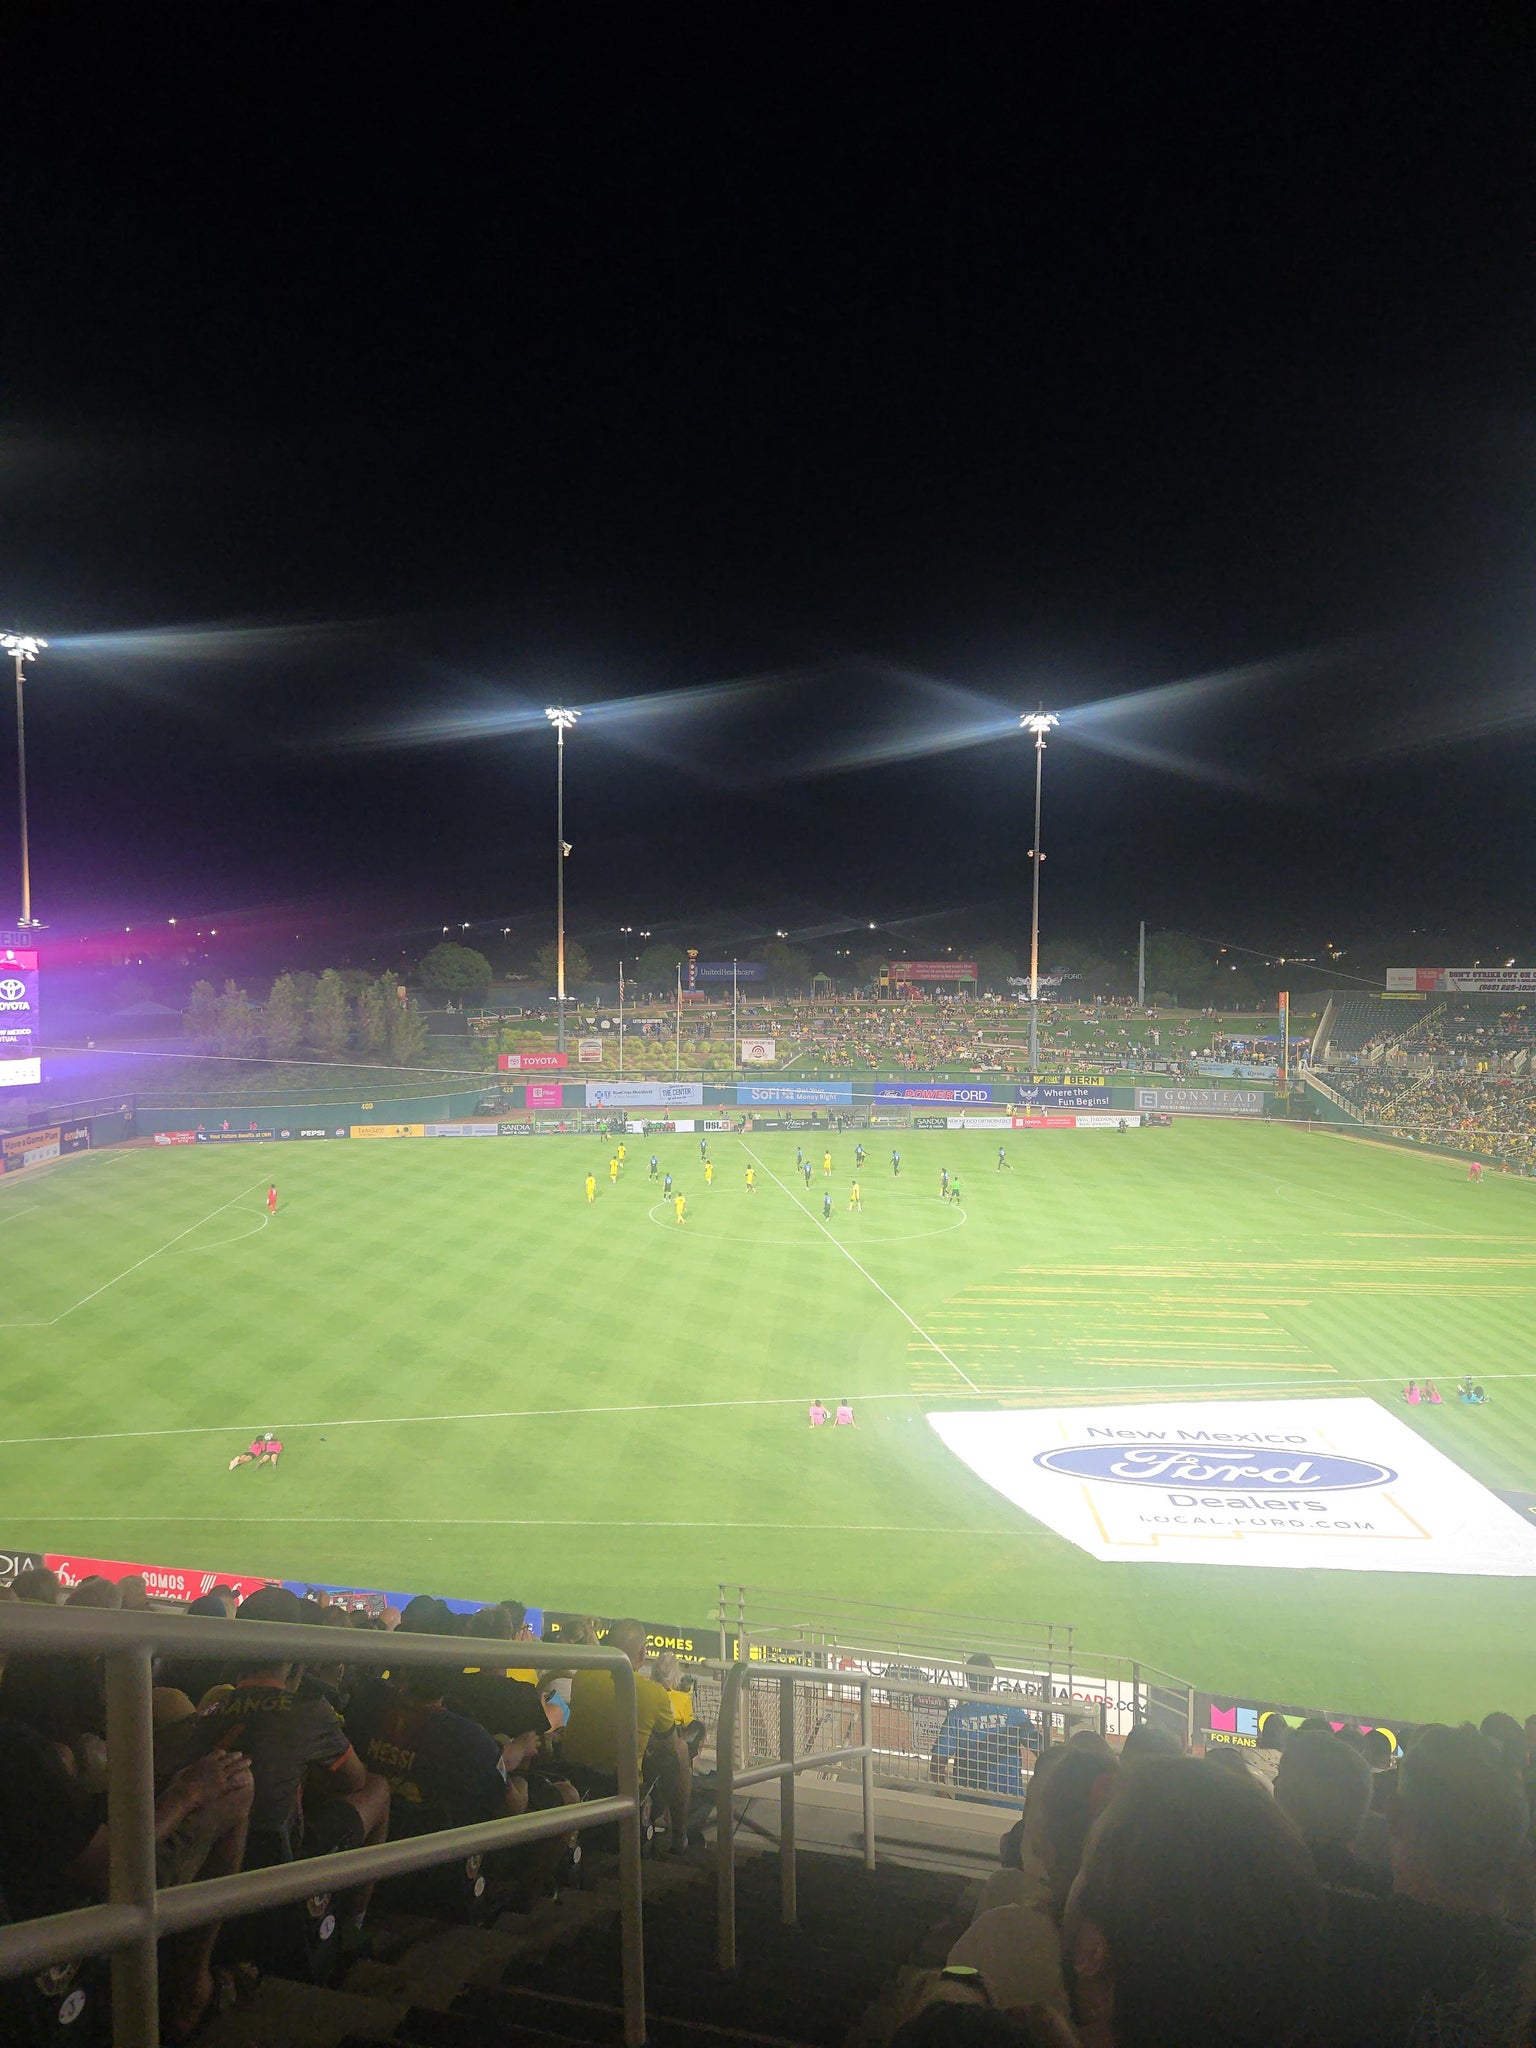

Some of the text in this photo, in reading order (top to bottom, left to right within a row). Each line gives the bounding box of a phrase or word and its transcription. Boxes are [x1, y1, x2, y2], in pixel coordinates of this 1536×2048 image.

[700, 968, 755, 976] UnitedHeathcare
[523, 1057, 558, 1065] TOYOTA
[1069, 1076, 1100, 1085] BERM
[1043, 1088, 1088, 1097] Where the
[1164, 1090, 1257, 1103] GONSTEAD
[1058, 1096, 1109, 1107] Fun Begins!
[5, 1141, 21, 1150] Have
[26, 1136, 45, 1145] Game
[45, 1132, 58, 1140] Plan
[301, 1129, 326, 1137] PEPSI
[1086, 1427, 1307, 1444] New Mexico
[1109, 1449, 1321, 1484] Ford
[1167, 1493, 1328, 1512] Dealers
[141, 1571, 185, 1591] SOMOS
[645, 1634, 693, 1652] COMES
[961, 1713, 1008, 1732] STAFF
[1210, 1733, 1257, 1748] FOR FANS
[367, 1737, 417, 1770] MESSI
